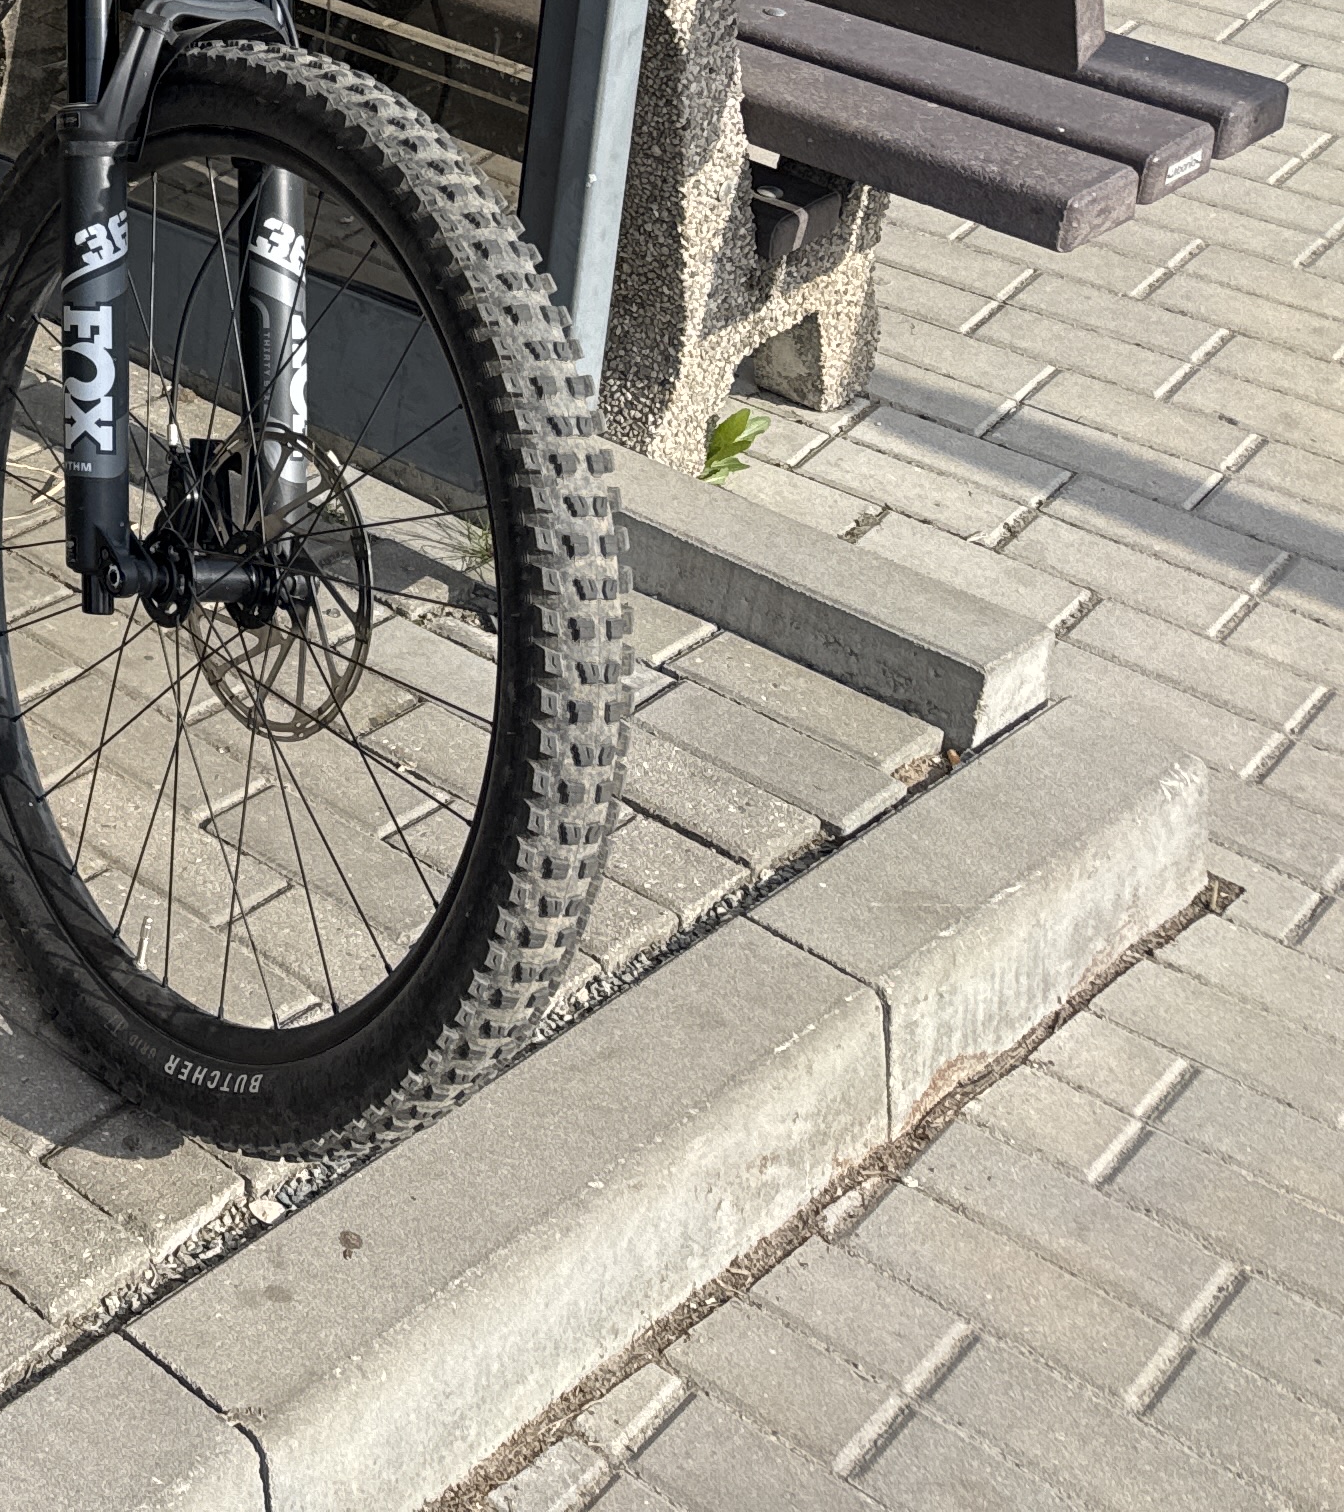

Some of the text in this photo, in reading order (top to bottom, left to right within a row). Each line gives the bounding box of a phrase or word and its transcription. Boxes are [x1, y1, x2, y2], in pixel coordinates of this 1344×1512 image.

[263, 331, 271, 377] THIRTY
[63, 304, 116, 452] FOX
[163, 1054, 264, 1094] BUTCHER
